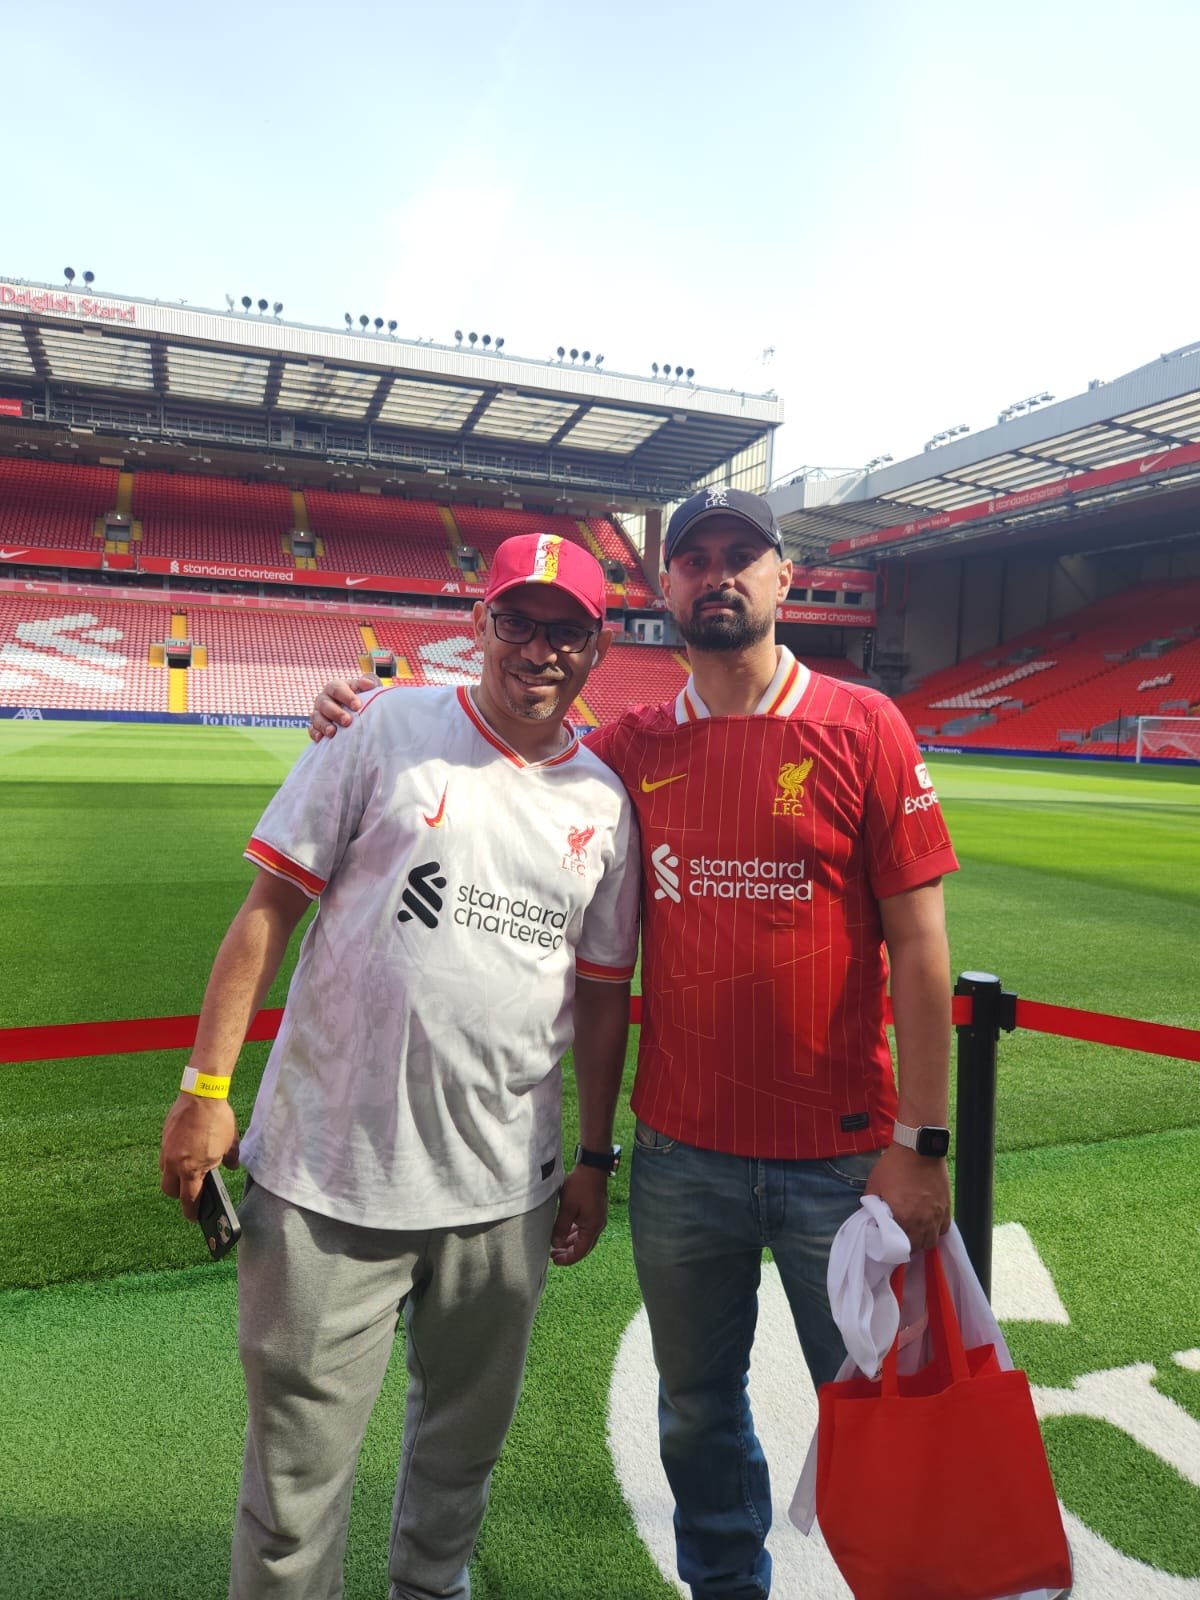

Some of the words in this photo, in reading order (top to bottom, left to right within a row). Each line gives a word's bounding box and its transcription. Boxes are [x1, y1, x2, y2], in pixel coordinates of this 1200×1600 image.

[0, 286, 76, 313] Dalglish
[81, 297, 136, 322] Stand
[183, 563, 237, 576] standard
[238, 567, 293, 581] chartered
[440, 583, 461, 594] AXA
[828, 612, 871, 623] chartered
[13, 708, 43, 720] AXA
[200, 714, 219, 726] To
[222, 714, 246, 726] the
[250, 715, 311, 728] Partners
[689, 856, 805, 879] standard
[689, 876, 812, 901] chartered
[457, 884, 569, 930] standard
